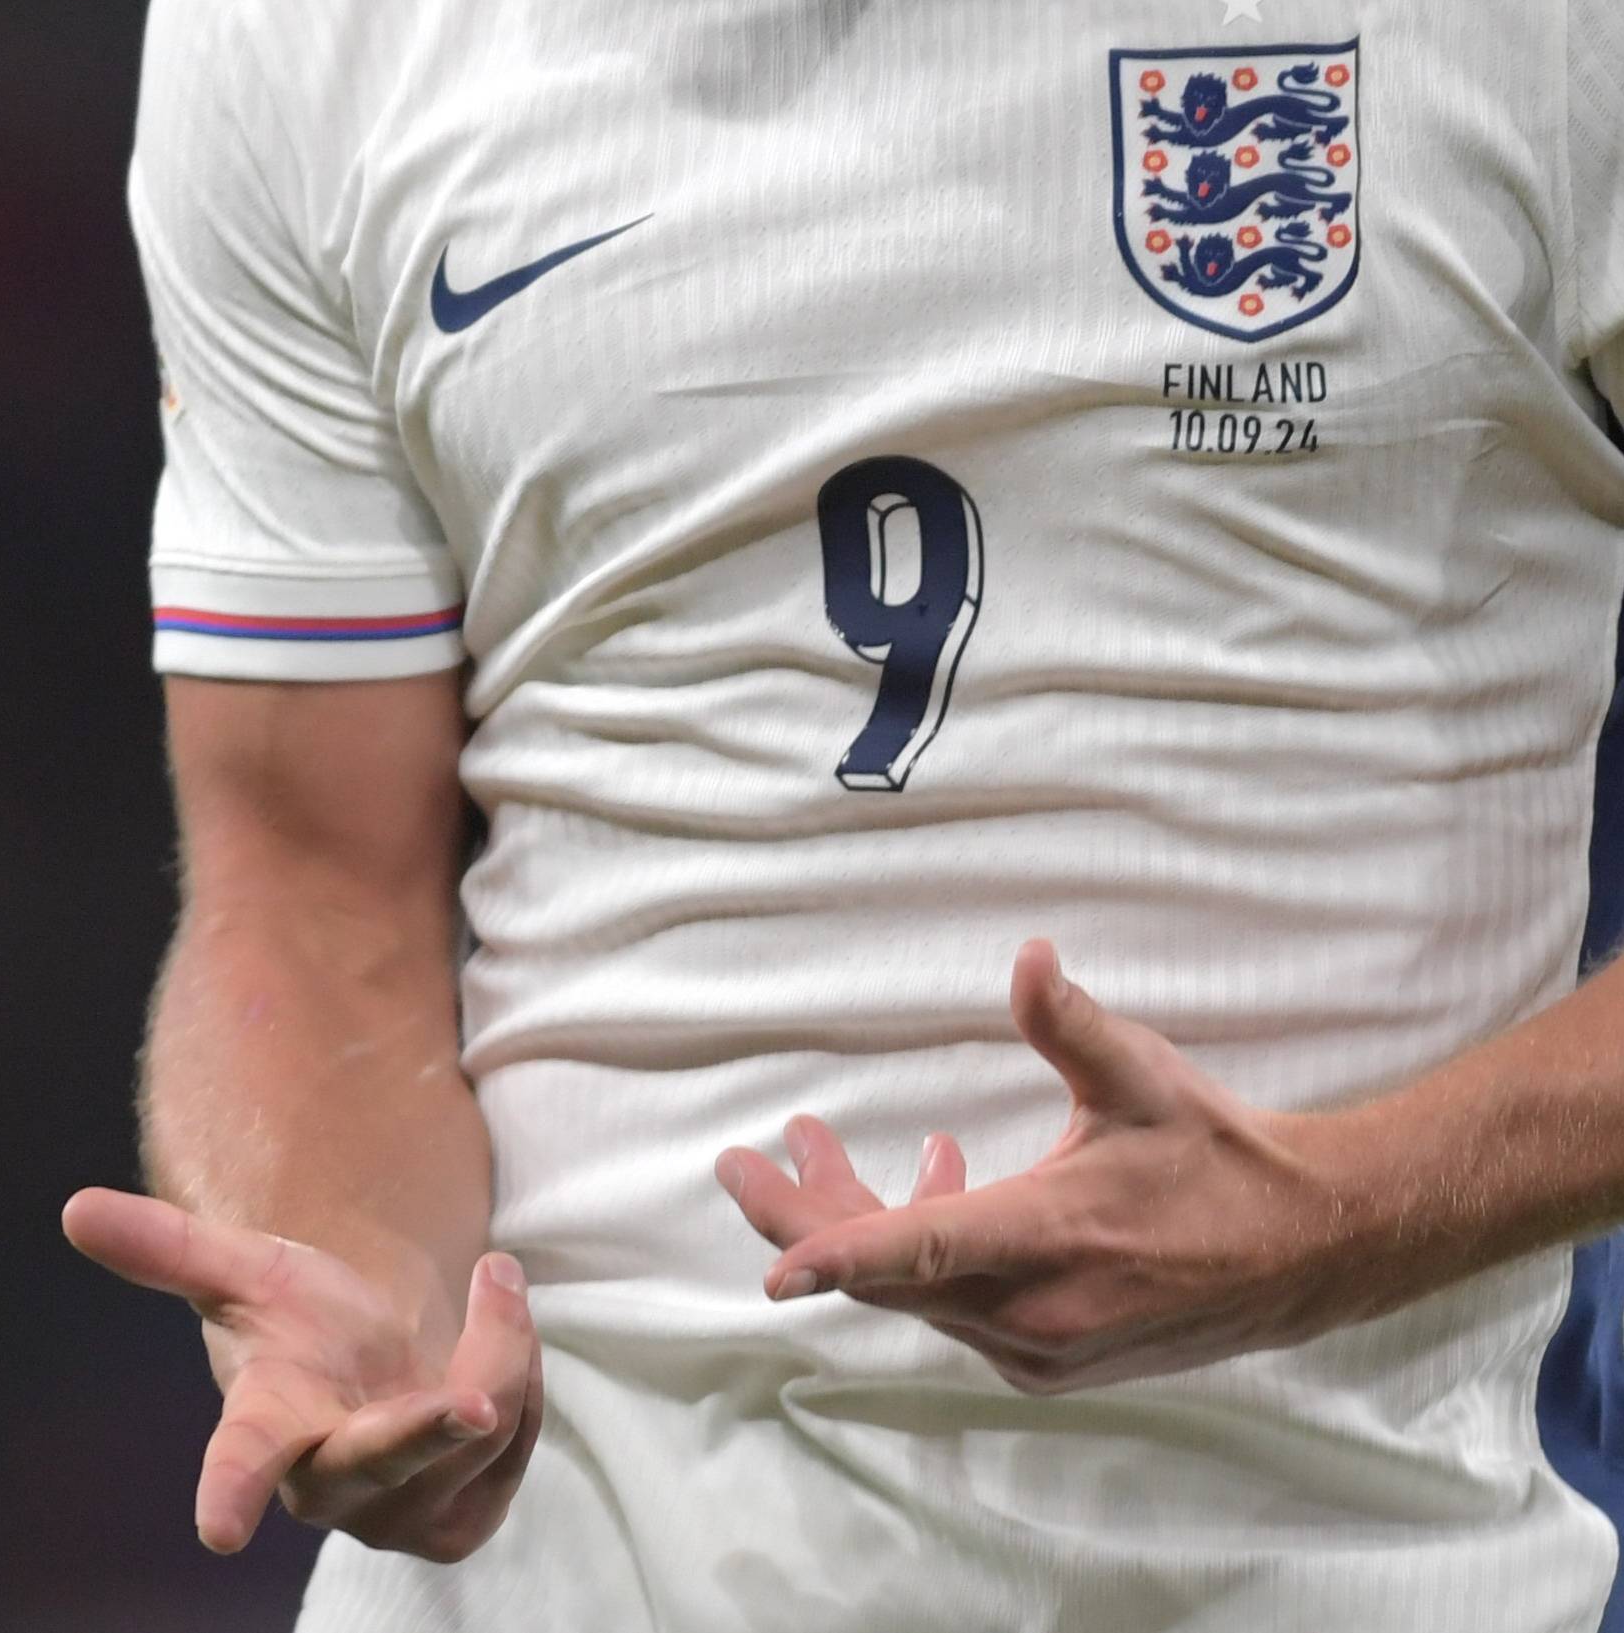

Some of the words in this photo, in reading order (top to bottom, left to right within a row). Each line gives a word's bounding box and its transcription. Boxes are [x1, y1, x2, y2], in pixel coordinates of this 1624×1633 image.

[1163, 361, 1327, 404] FINLAND
[1170, 409, 1319, 455] 10.09.24
[817, 454, 985, 792] 9
